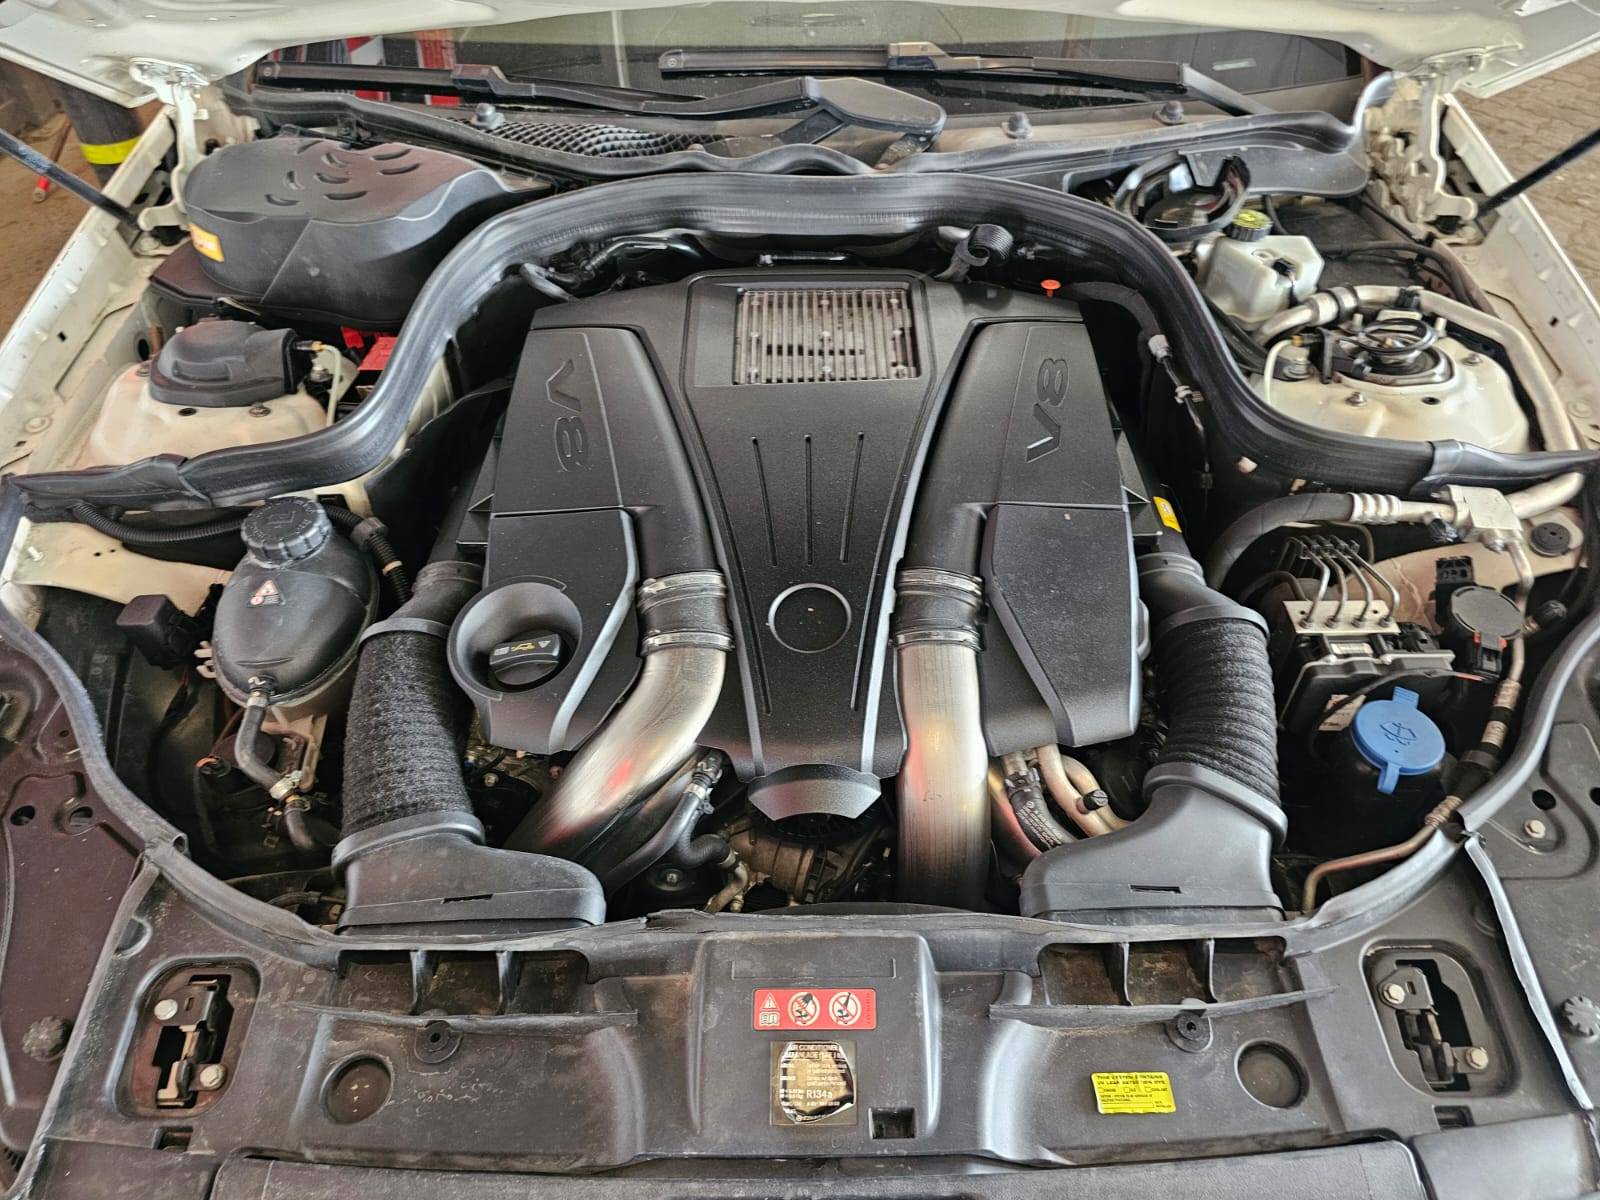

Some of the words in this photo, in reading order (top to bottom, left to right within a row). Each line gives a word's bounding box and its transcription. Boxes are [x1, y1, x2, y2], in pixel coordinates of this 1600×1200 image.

[545, 359, 588, 472] V8
[1026, 358, 1069, 464] V8
[806, 1089, 833, 1099] R134a
